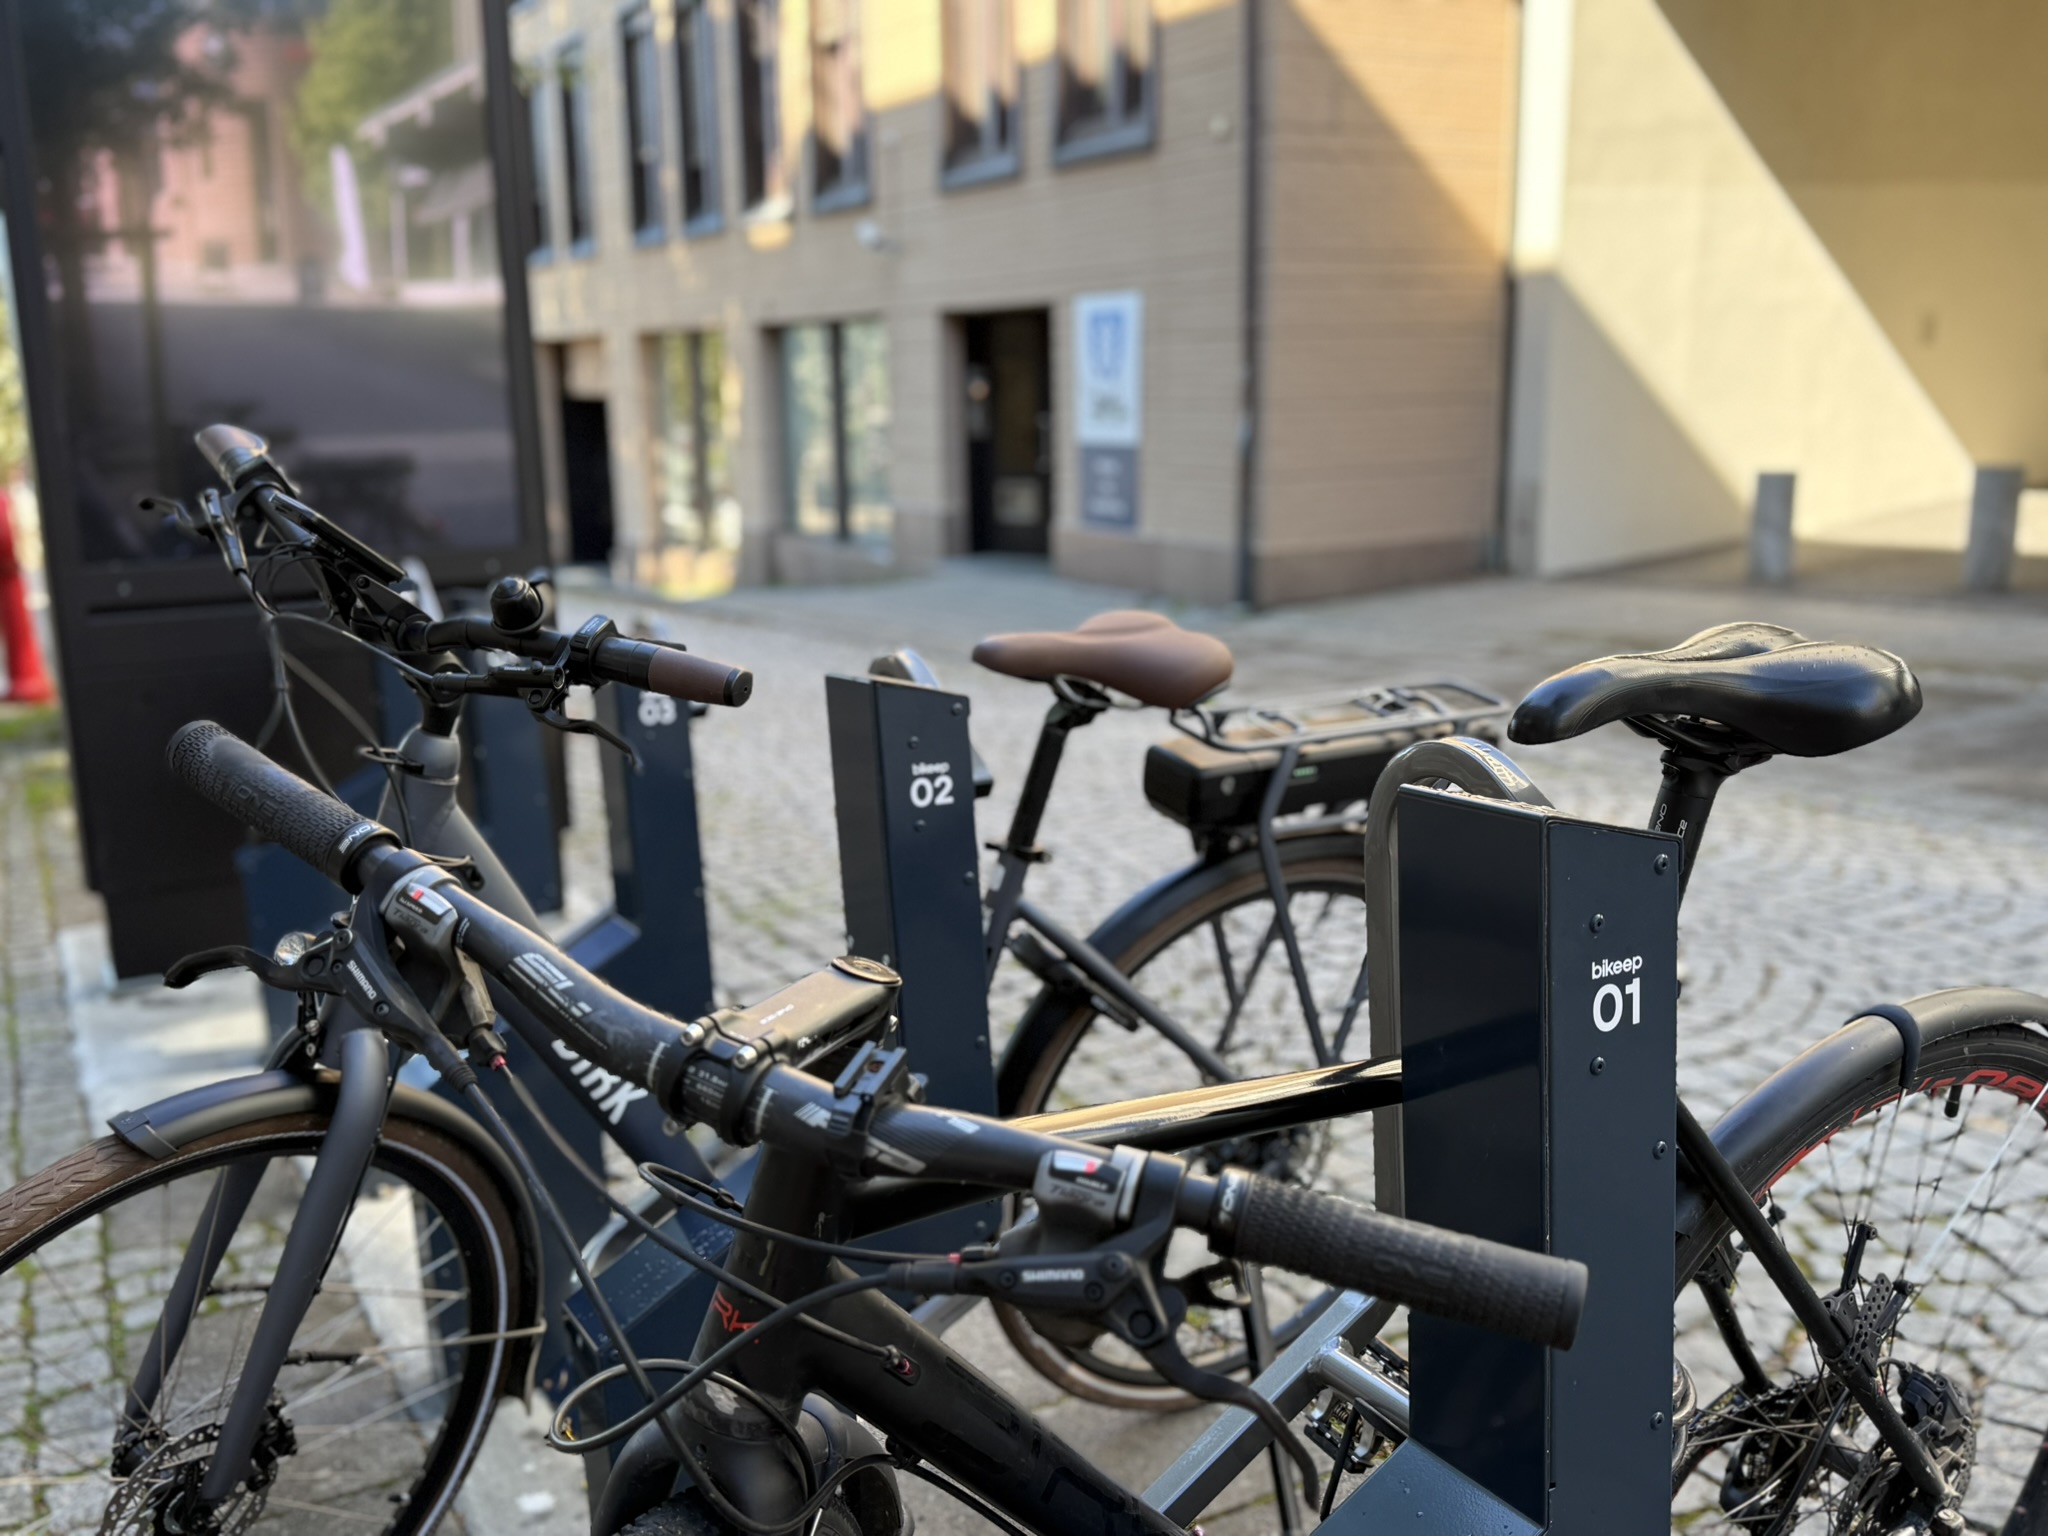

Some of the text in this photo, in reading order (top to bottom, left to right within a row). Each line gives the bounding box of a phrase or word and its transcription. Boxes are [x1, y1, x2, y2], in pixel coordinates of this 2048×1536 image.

[638, 697, 678, 727] 03
[912, 761, 950, 776] bikeep
[909, 775, 955, 808] 02
[346, 959, 377, 1000] SHIMANO
[1591, 955, 1643, 980] bikeep
[1593, 977, 1641, 1032] 01
[1021, 1268, 1085, 1283] SHIMANO
